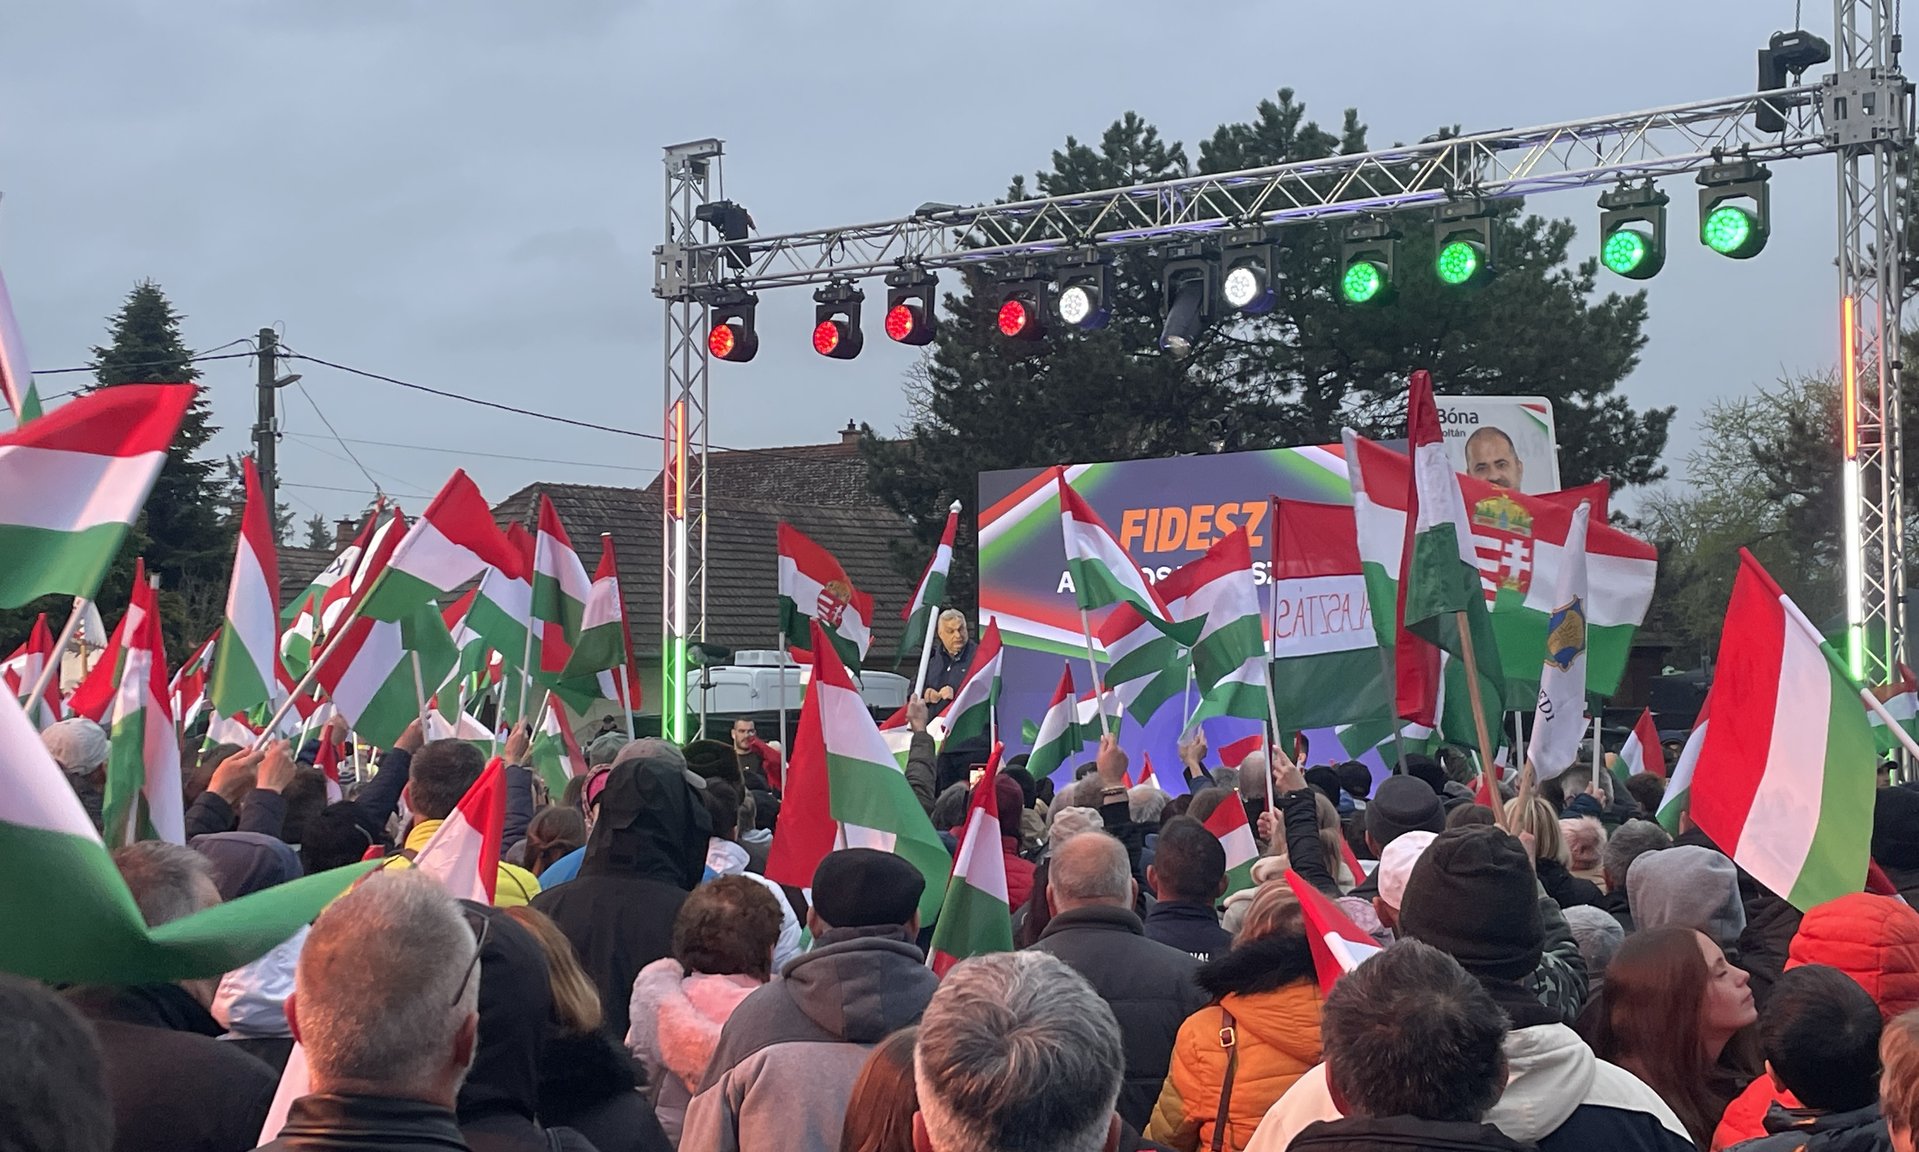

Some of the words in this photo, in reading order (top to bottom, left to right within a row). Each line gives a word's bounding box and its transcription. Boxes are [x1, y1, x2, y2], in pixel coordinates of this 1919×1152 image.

[1438, 407, 1479, 424] Bóna
[1443, 429, 1466, 437] oltán
[1120, 501, 1268, 552] FIDESZ
